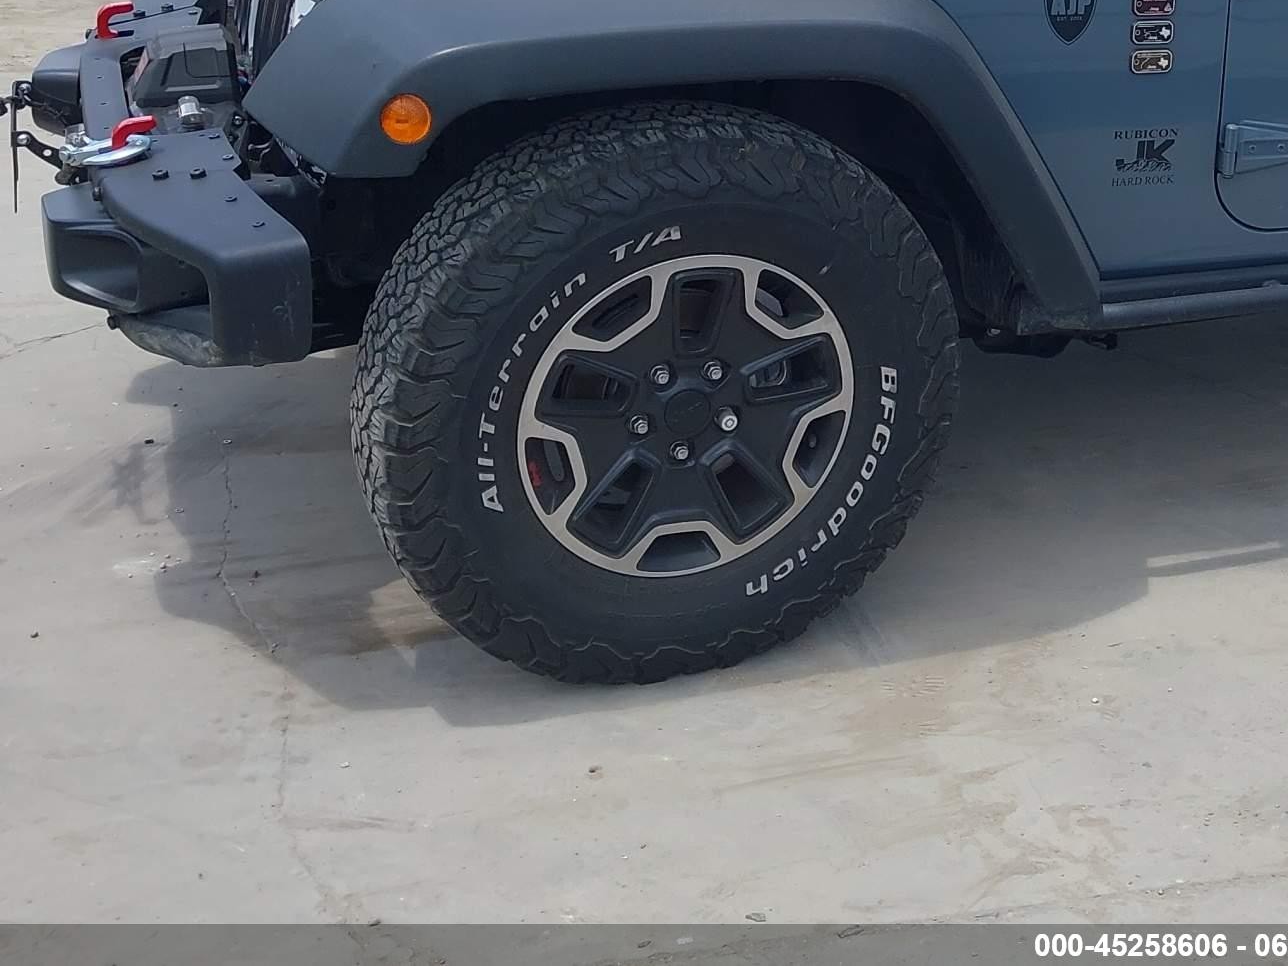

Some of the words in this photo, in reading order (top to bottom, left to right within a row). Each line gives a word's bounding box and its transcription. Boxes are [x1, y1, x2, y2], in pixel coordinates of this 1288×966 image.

[1111, 176, 1143, 187] HARD
[1144, 174, 1176, 186] ROCK
[1114, 128, 1178, 140] RUBICON
[477, 271, 588, 514] All-Terrain
[607, 225, 683, 263] T/A
[744, 364, 899, 599] BFGoodrich
